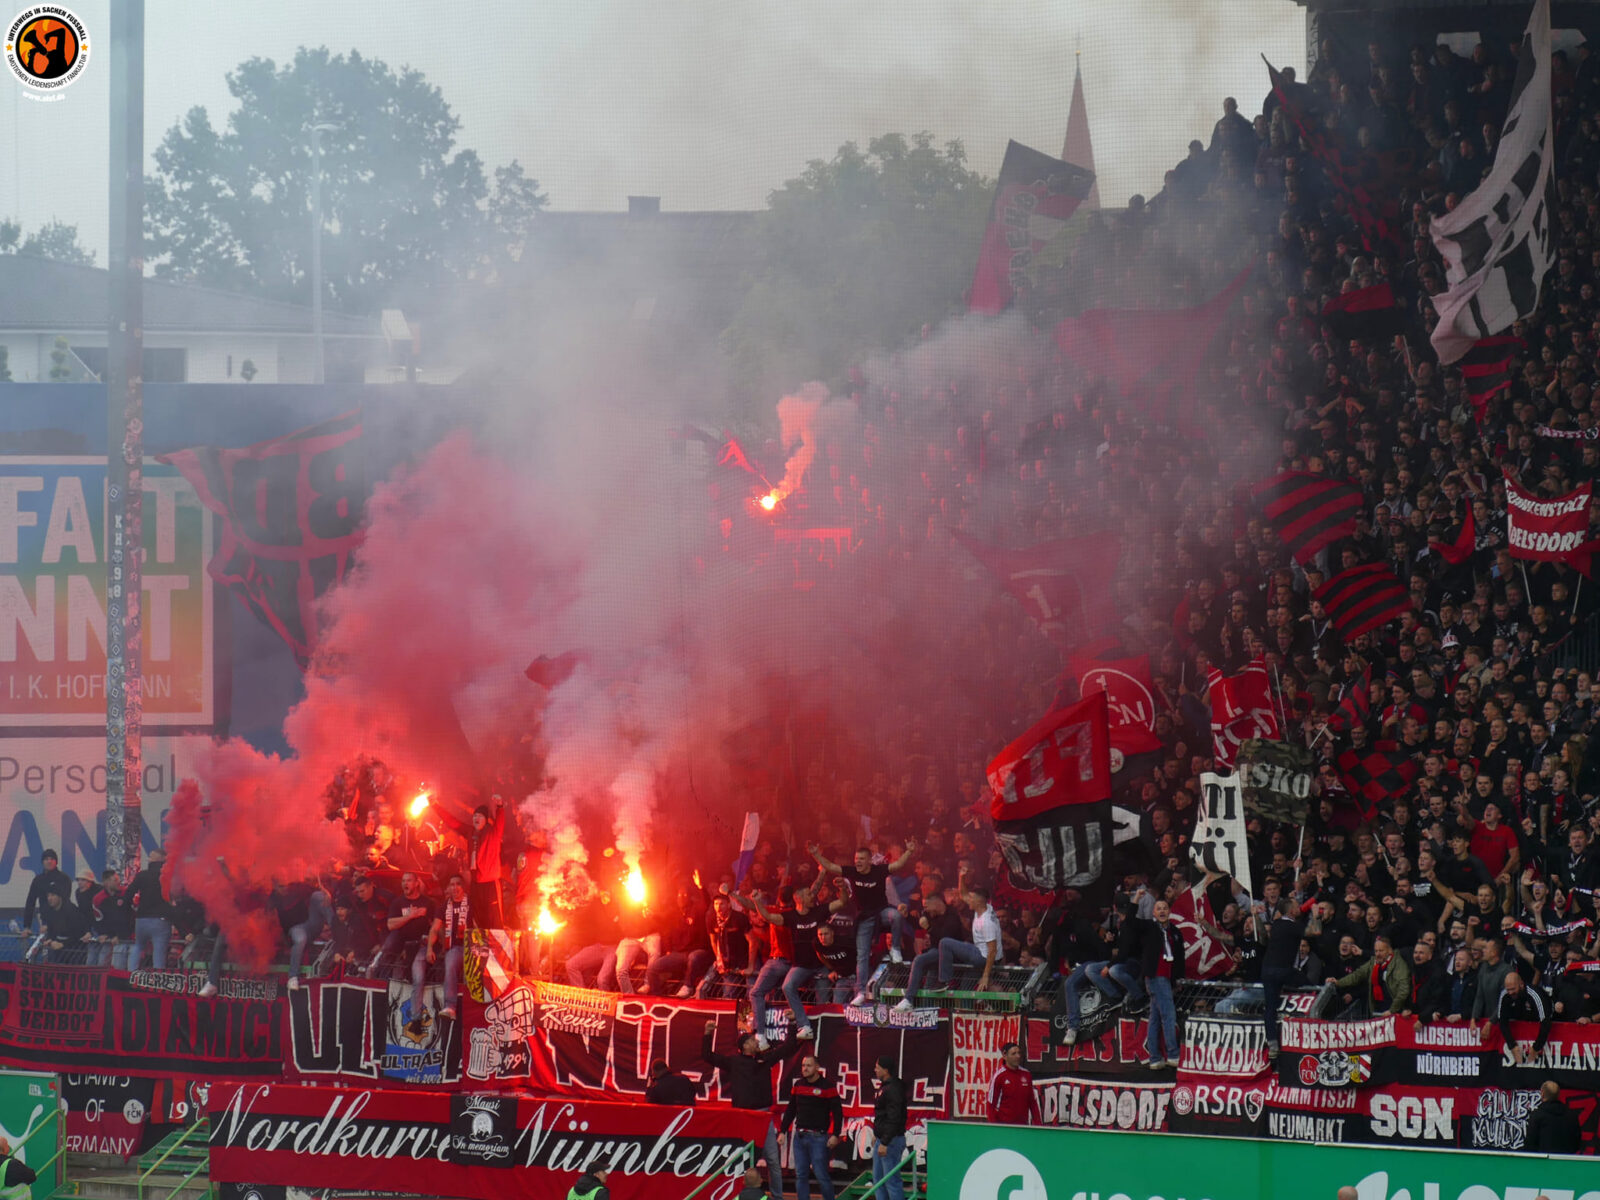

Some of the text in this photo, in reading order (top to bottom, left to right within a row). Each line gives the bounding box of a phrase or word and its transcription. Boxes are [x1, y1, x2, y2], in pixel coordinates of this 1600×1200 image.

[0, 476, 192, 563] FAT
[28, 675, 48, 699] K.
[56, 675, 172, 699] HOFNN
[0, 753, 176, 794] Persoal
[20, 969, 102, 992] SEKTION
[19, 988, 99, 1012] STADION
[19, 1009, 95, 1032] VERBOT
[165, 1000, 283, 1060] AMICI
[540, 1004, 607, 1030] Kevin
[954, 1016, 1019, 1052] SEKTION
[1182, 1020, 1267, 1074] H3RZBLU
[1282, 1016, 1396, 1049] DIE BESESSENEN
[380, 1051, 443, 1073] ULTRAS
[504, 1053, 528, 1070] 1994
[955, 1055, 1004, 1084] STADI
[1417, 1053, 1479, 1076] NÜRNBERG
[85, 1098, 106, 1122] OF
[126, 1110, 142, 1119] FCN
[955, 1089, 987, 1120] VER
[1194, 1085, 1242, 1116] RSR
[208, 1083, 451, 1162] Nordkurve
[1269, 1112, 1345, 1144] NEUMARKT
[1370, 1094, 1455, 1140] SGN
[65, 1135, 135, 1155] ERMANY
[514, 1102, 750, 1200] Nürnberg
